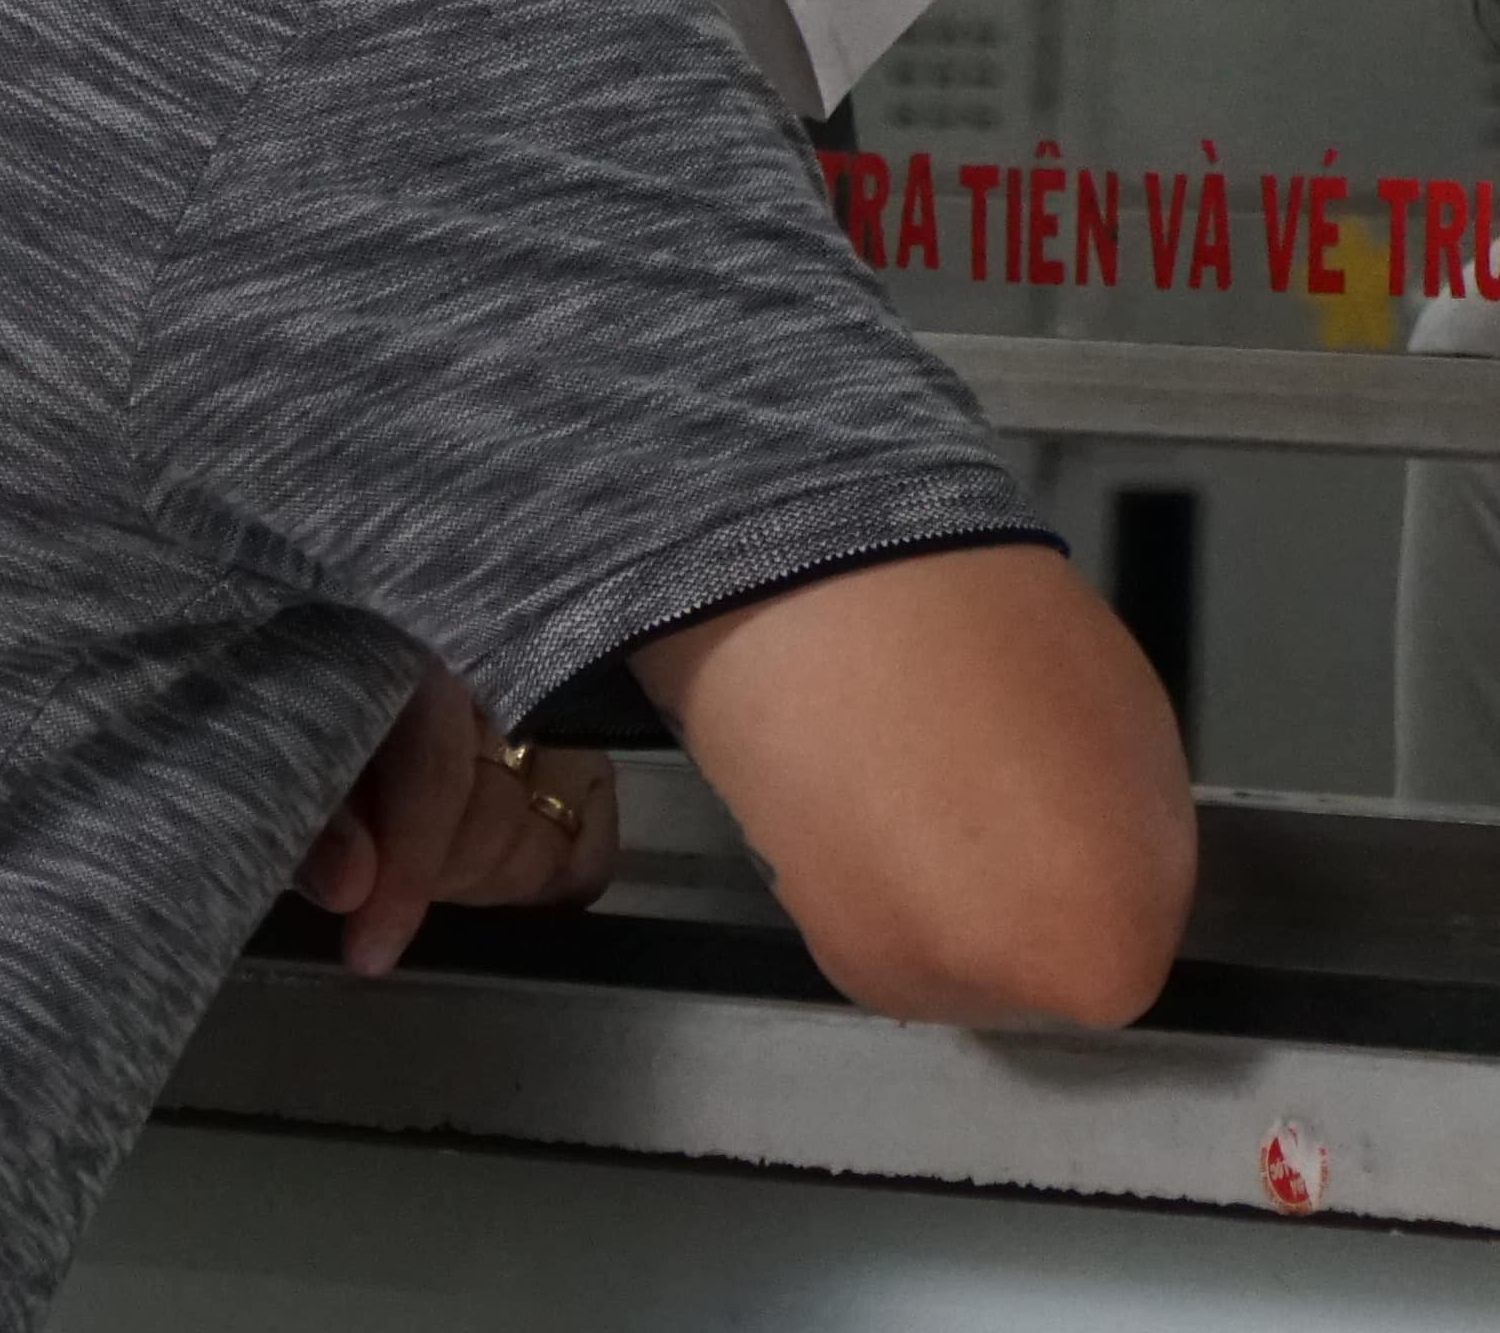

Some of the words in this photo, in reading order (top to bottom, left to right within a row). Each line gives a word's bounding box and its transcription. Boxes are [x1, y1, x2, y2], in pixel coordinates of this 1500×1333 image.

[814, 149, 940, 270] TRA
[1145, 139, 1233, 291] VÀ
[1261, 148, 1349, 295] VÉ
